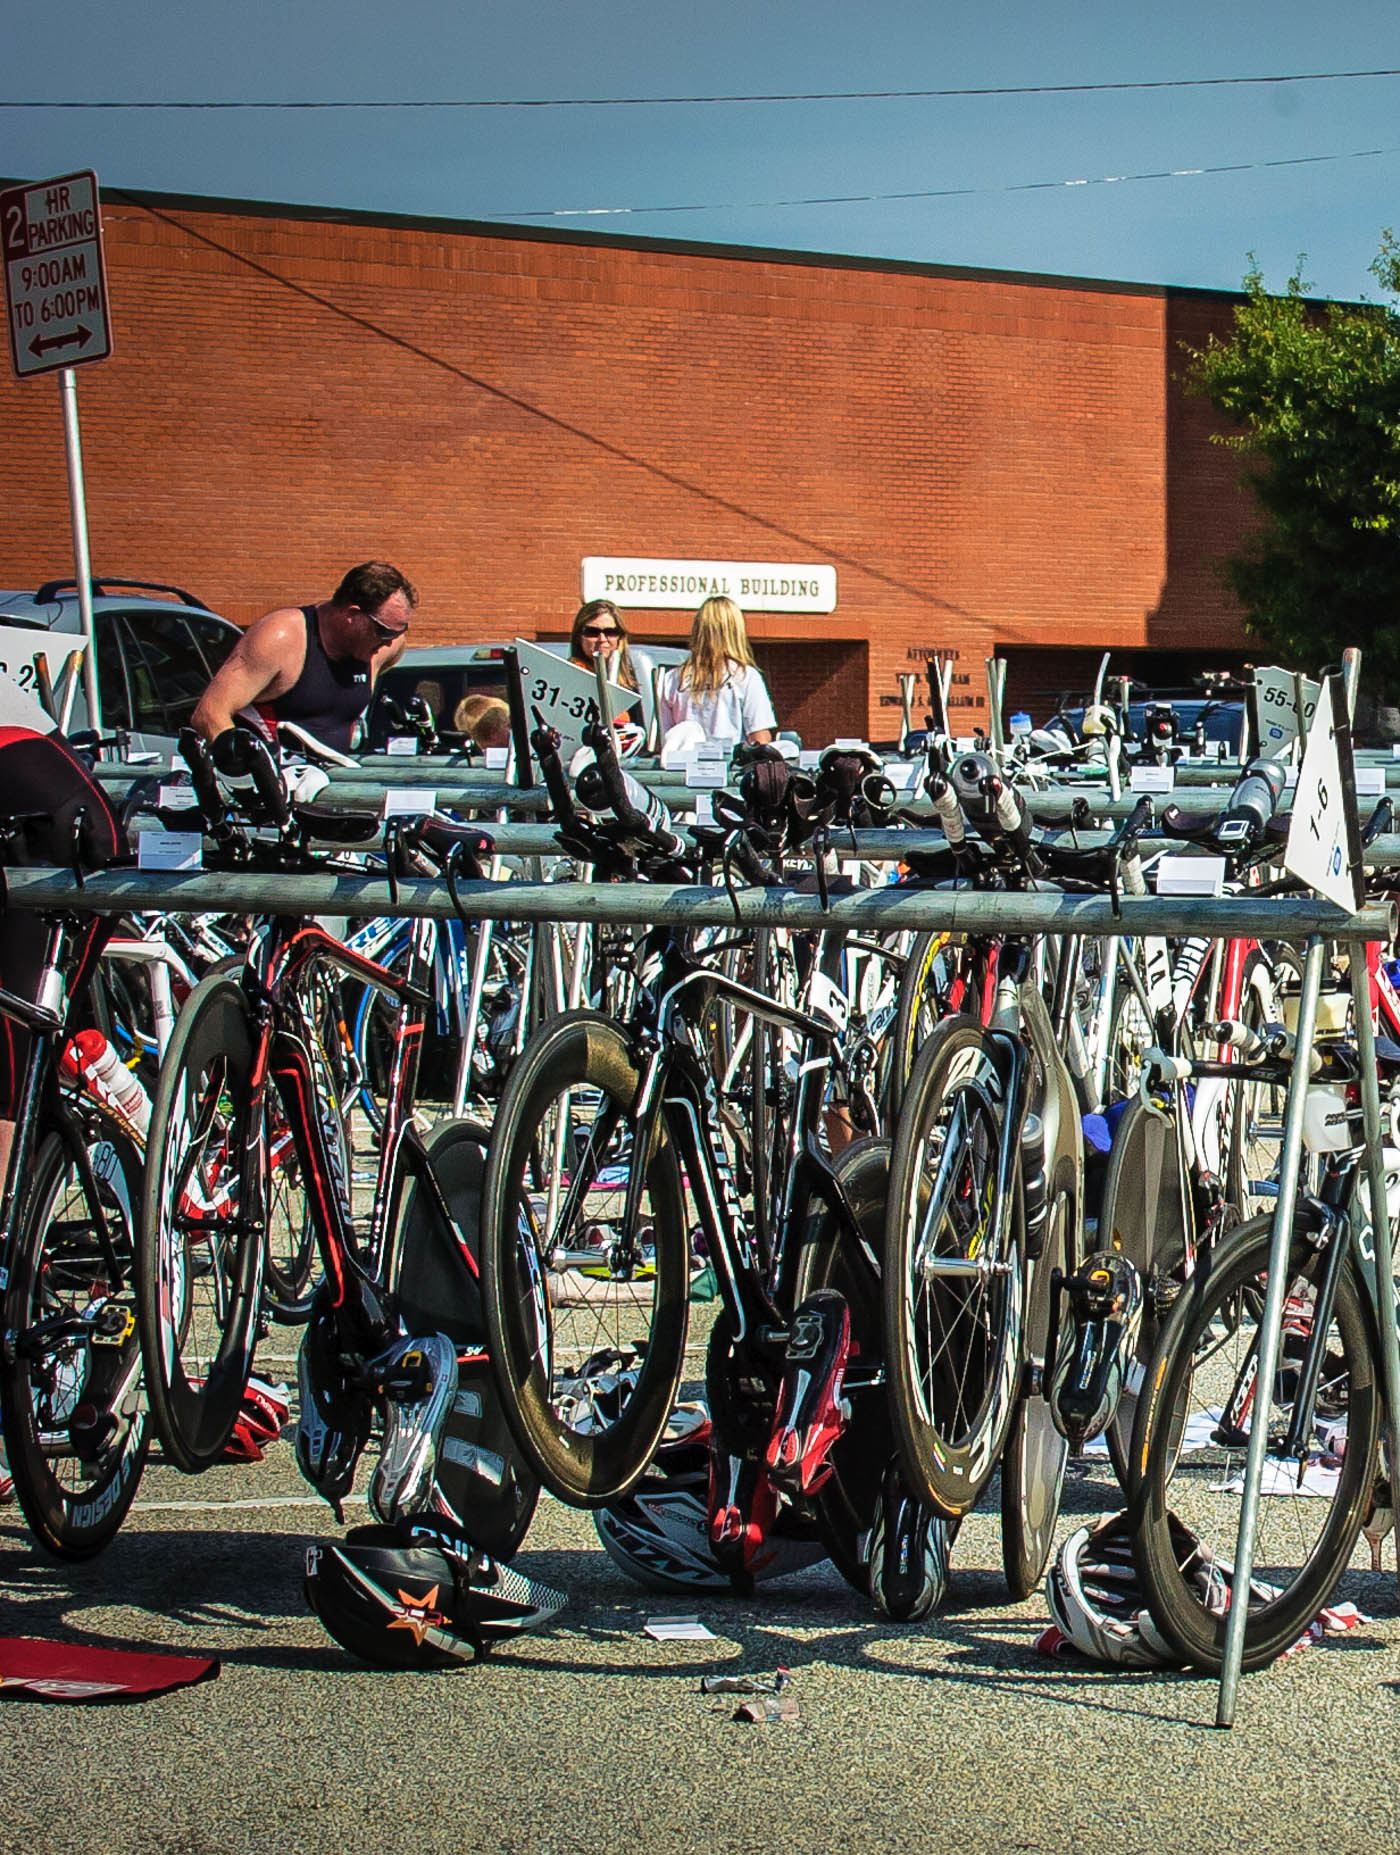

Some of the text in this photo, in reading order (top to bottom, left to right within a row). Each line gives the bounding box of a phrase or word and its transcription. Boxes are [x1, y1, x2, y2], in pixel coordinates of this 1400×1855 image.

[45, 186, 71, 215] HR
[6, 205, 25, 248] 2
[29, 209, 95, 249] PARKING
[21, 254, 86, 292] 9:00AM
[15, 285, 101, 328] TO 6:00PM
[604, 574, 820, 597] PROFESSIONAL BUILDING
[1309, 778, 1328, 841] 1-6
[829, 990, 846, 1019] 3
[72, 1470, 121, 1528] DESIGN
